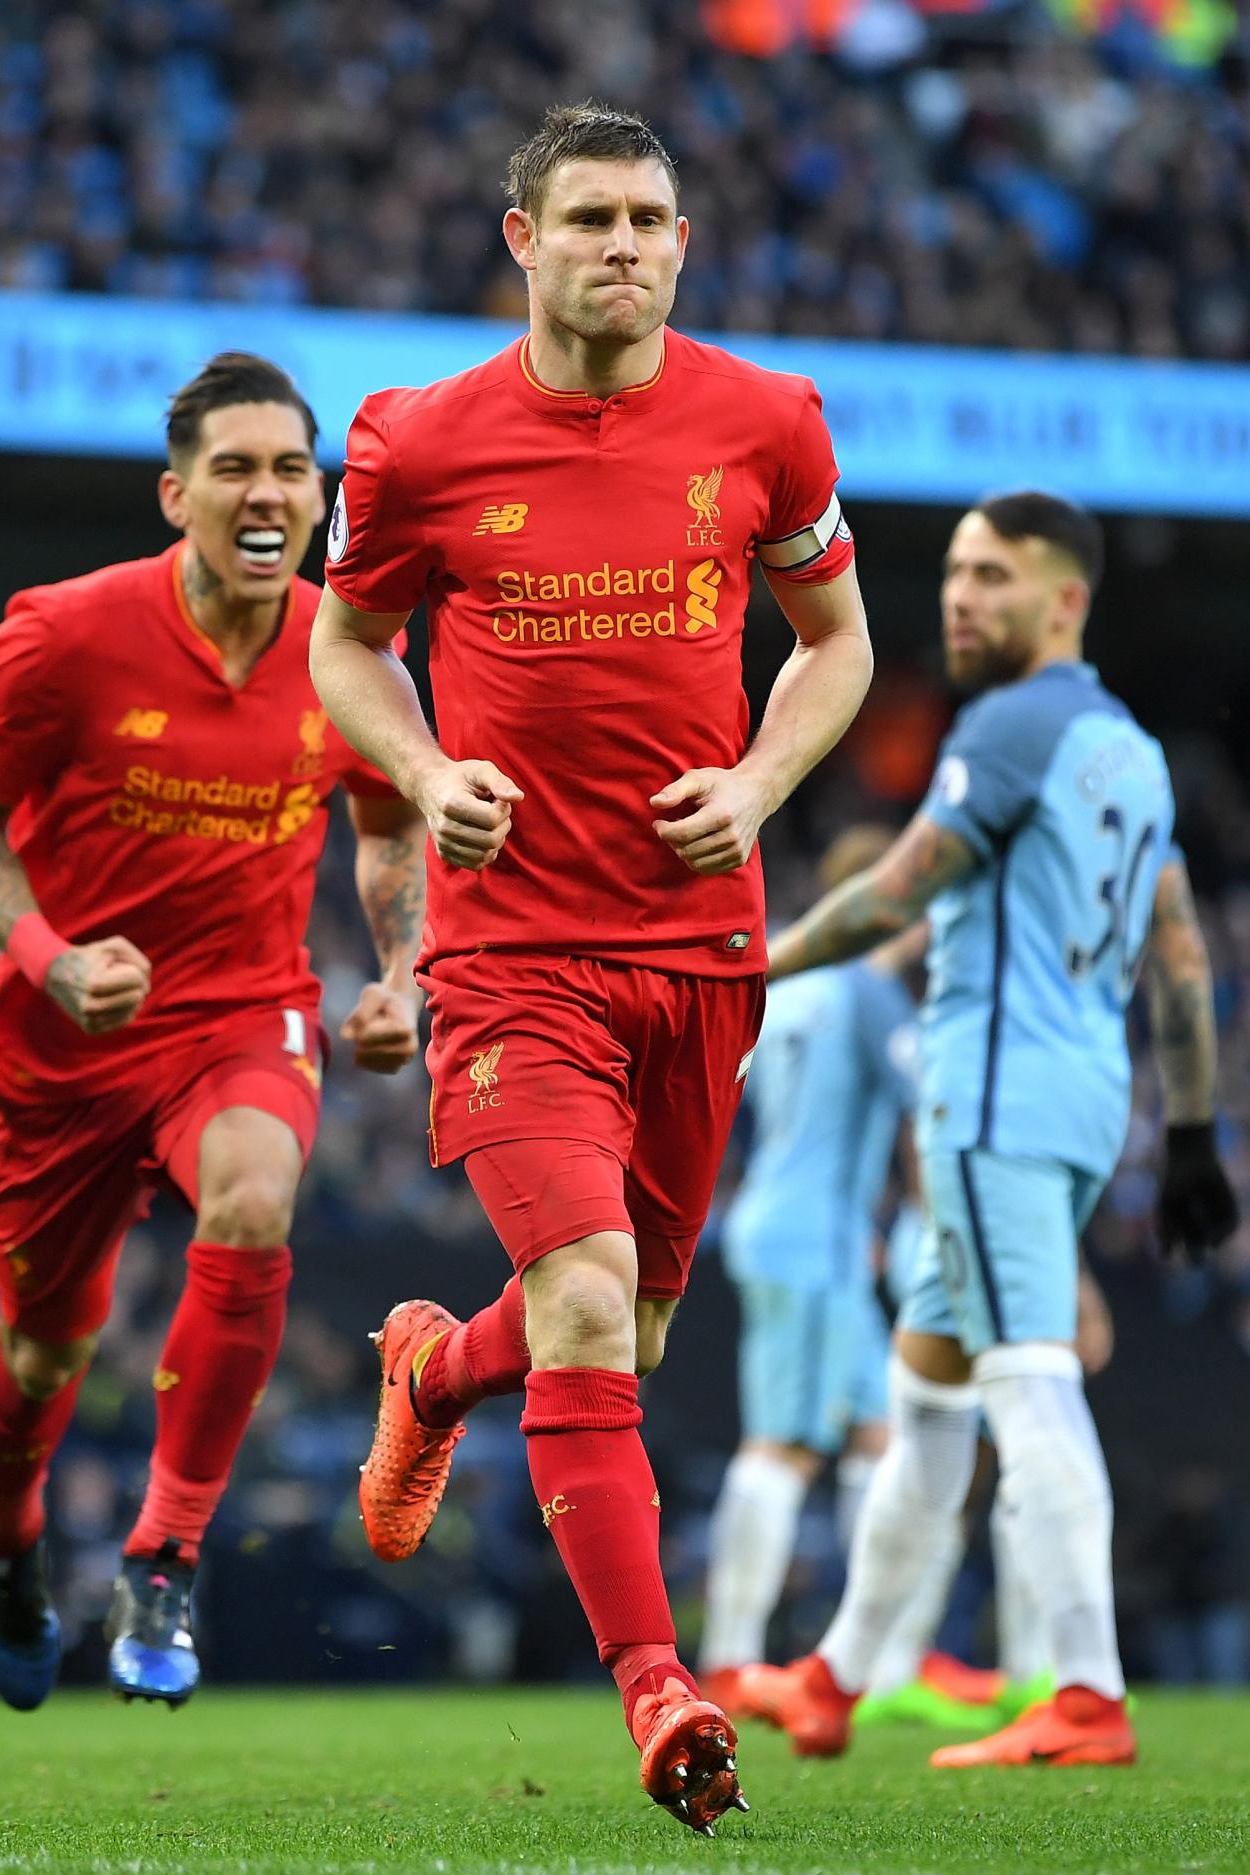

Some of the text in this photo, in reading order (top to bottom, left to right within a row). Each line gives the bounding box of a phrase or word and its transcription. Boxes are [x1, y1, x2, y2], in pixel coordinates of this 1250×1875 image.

[472, 503, 529, 536] NB
[687, 530, 725, 546] L.F.C.
[497, 560, 675, 603] Standard
[493, 602, 676, 642] Chartered
[124, 765, 280, 810] Standard
[110, 798, 270, 845] Chartered
[1066, 805, 1156, 980] 30
[467, 1093, 505, 1114] L.F.C.
